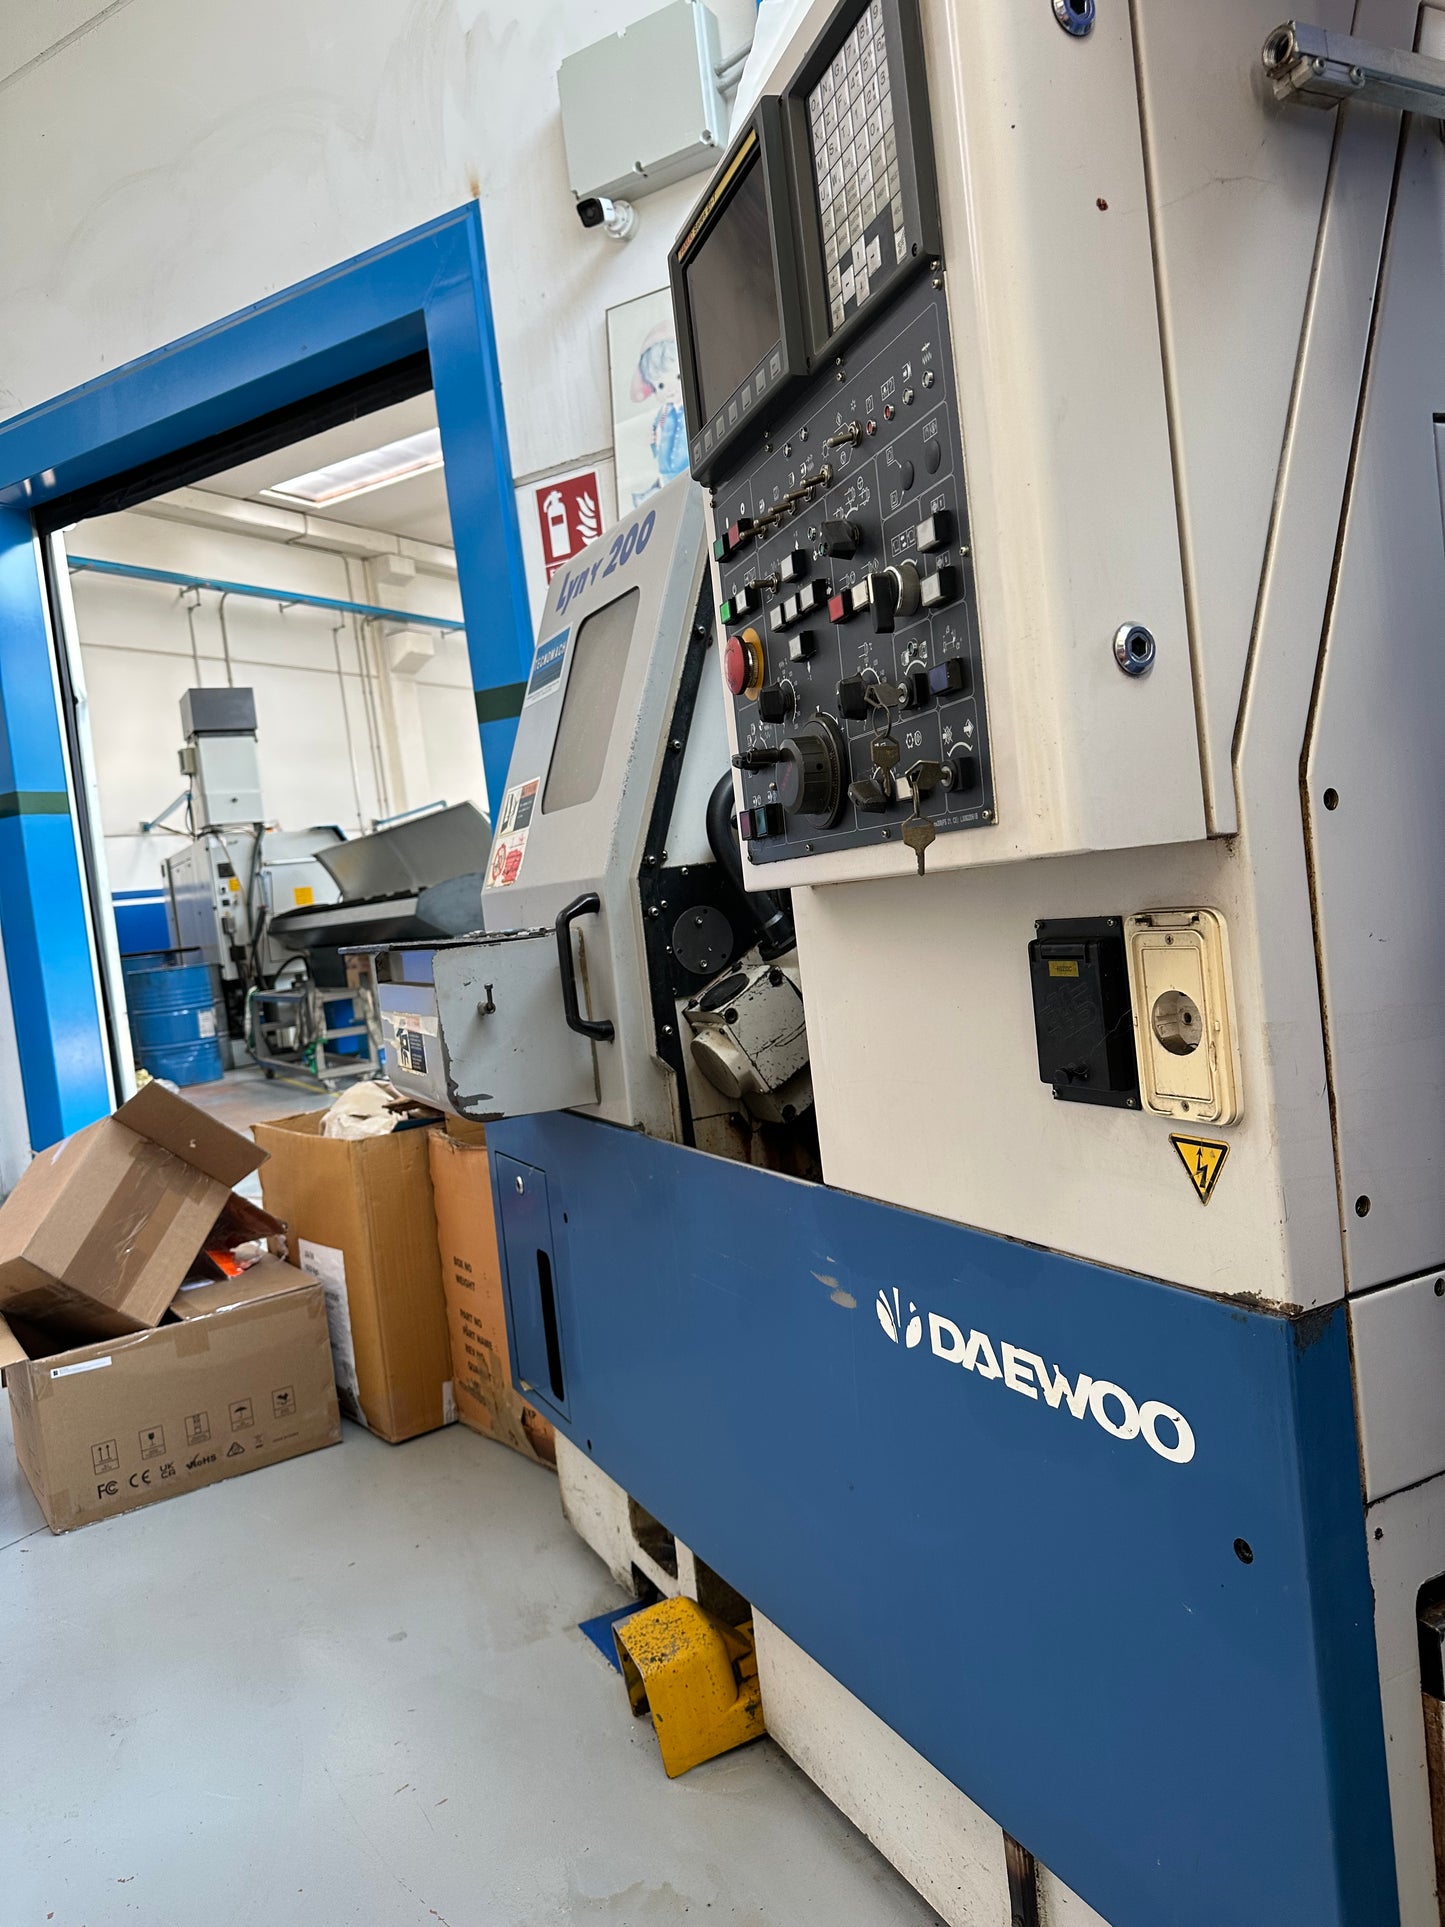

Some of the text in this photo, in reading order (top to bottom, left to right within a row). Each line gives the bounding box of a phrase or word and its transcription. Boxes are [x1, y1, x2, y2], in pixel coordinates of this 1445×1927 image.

[602, 510, 656, 578] 200
[928, 1311, 1196, 1464] DAEWOO
[129, 1468, 152, 1488] CE
